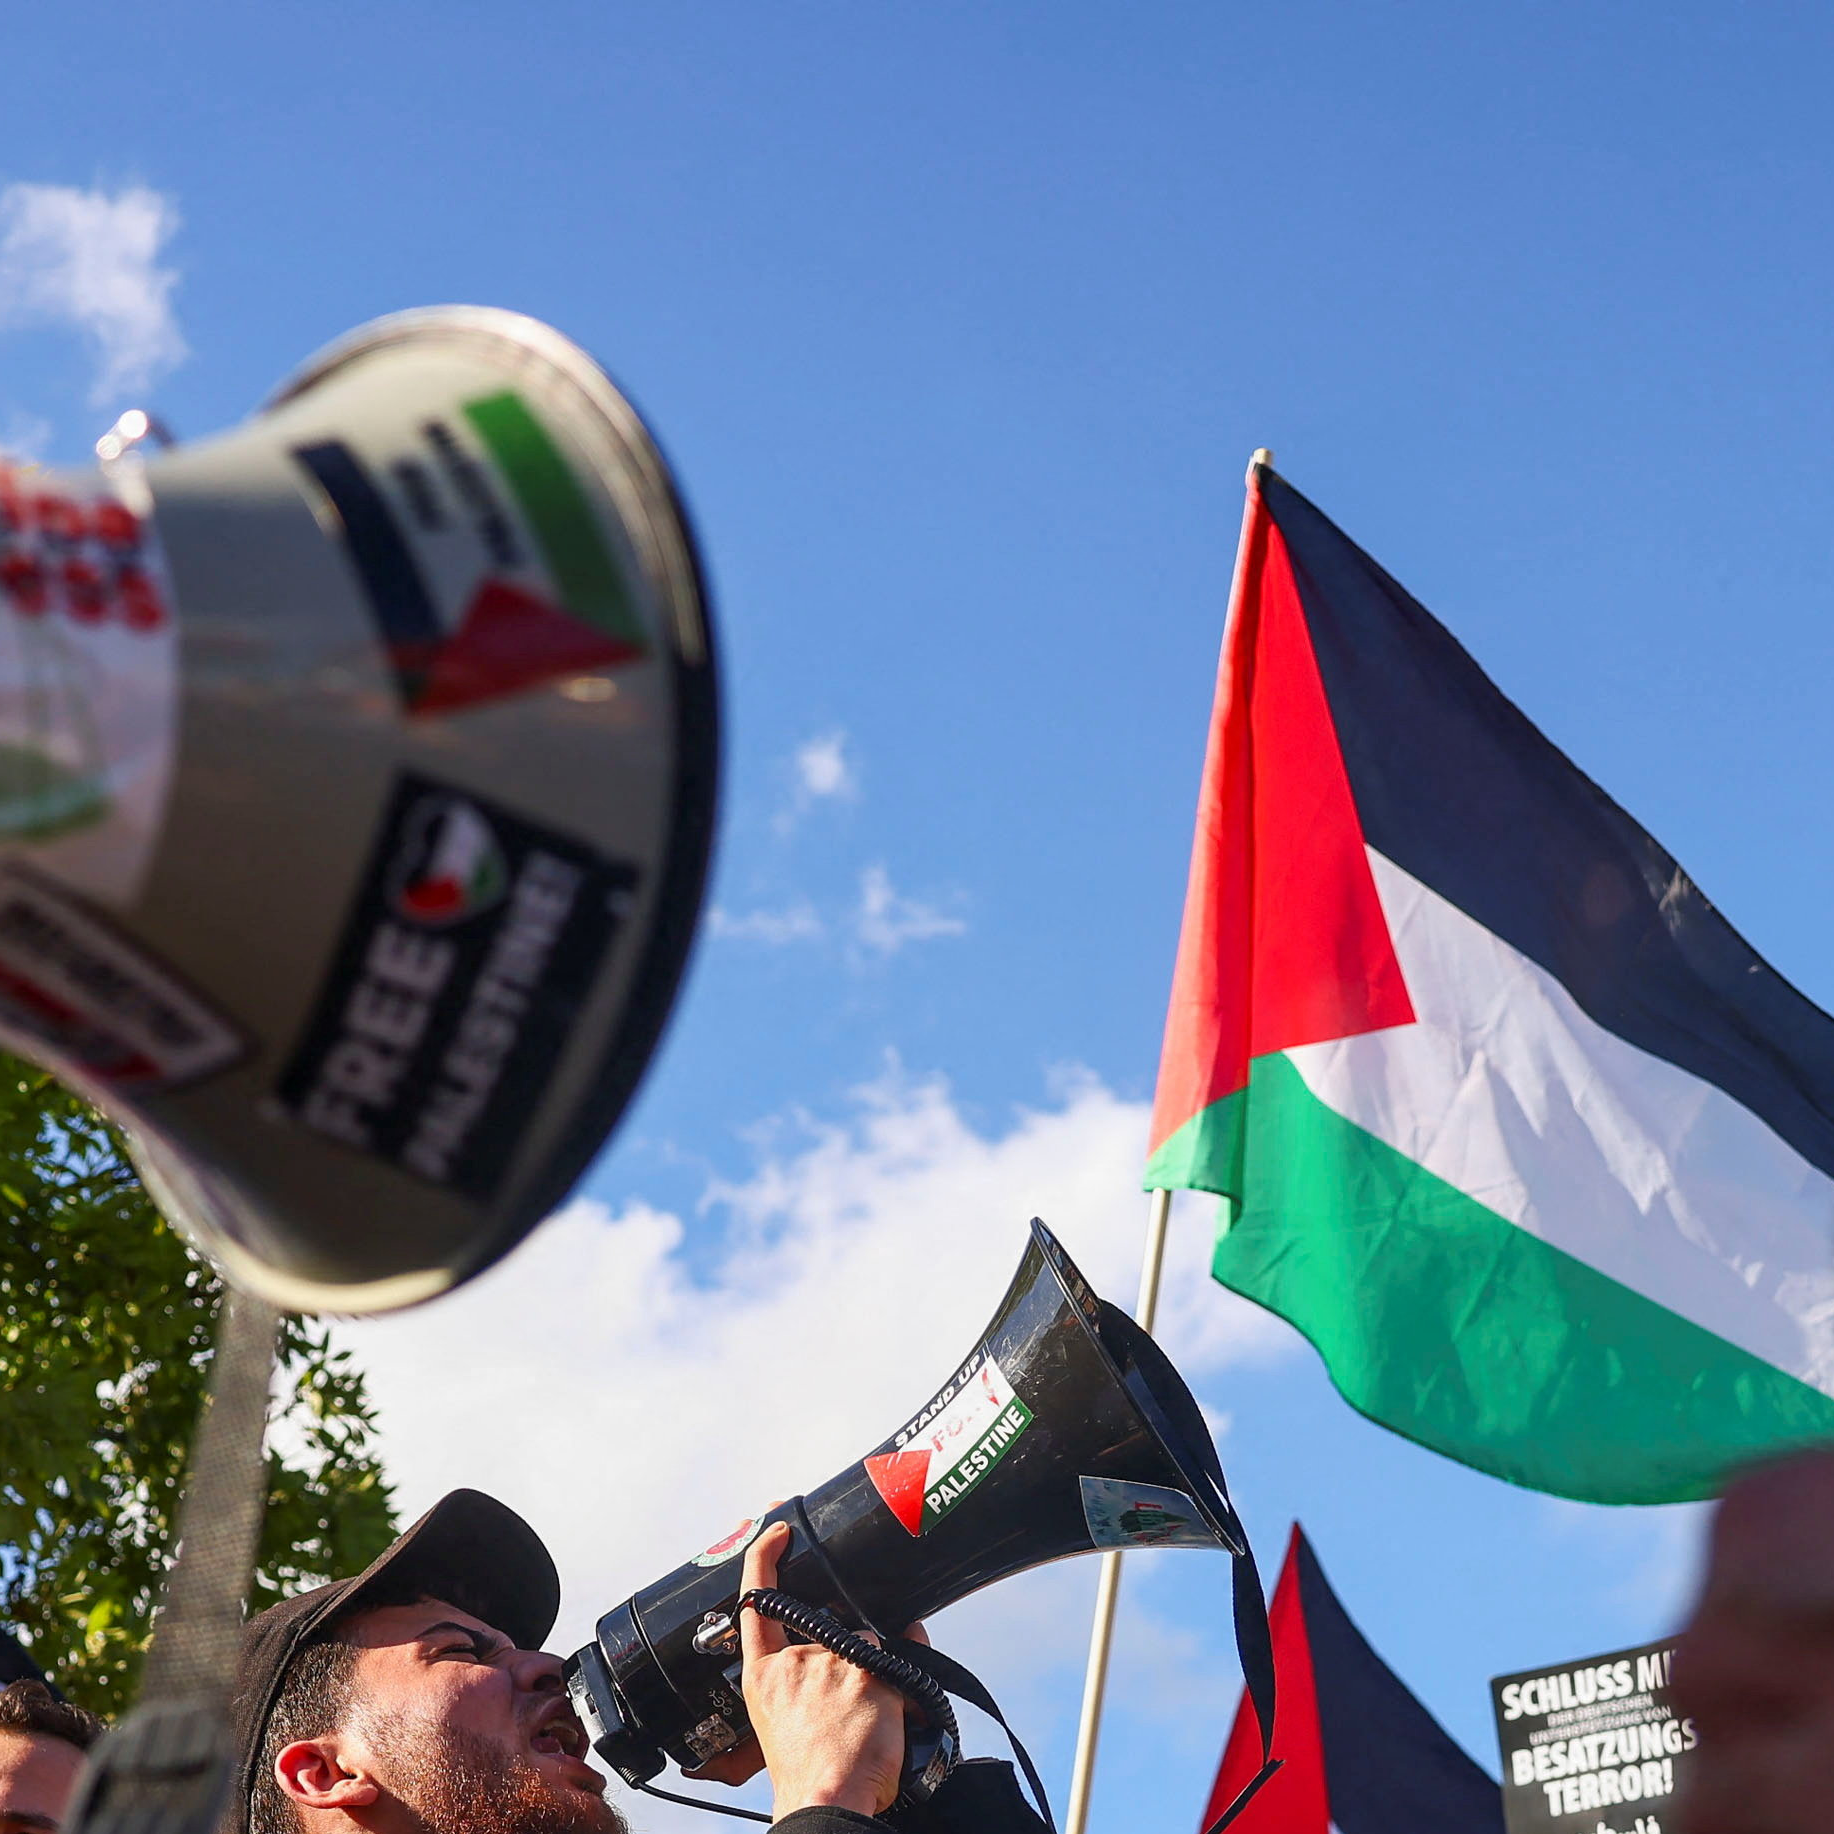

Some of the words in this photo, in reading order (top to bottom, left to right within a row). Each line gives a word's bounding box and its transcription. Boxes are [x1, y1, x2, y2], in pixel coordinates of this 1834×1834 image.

[299, 920, 459, 1150] FREE
[894, 1385, 955, 1449] STAND
[957, 1354, 981, 1387] UP
[925, 1405, 1026, 1514] PALESTINE
[1501, 1659, 1635, 1721] SCHLUSS
[1637, 1650, 1676, 1693] MI
[1511, 1717, 1700, 1787] BESATZUNGS
[1543, 1758, 1674, 1817] TERROR!
